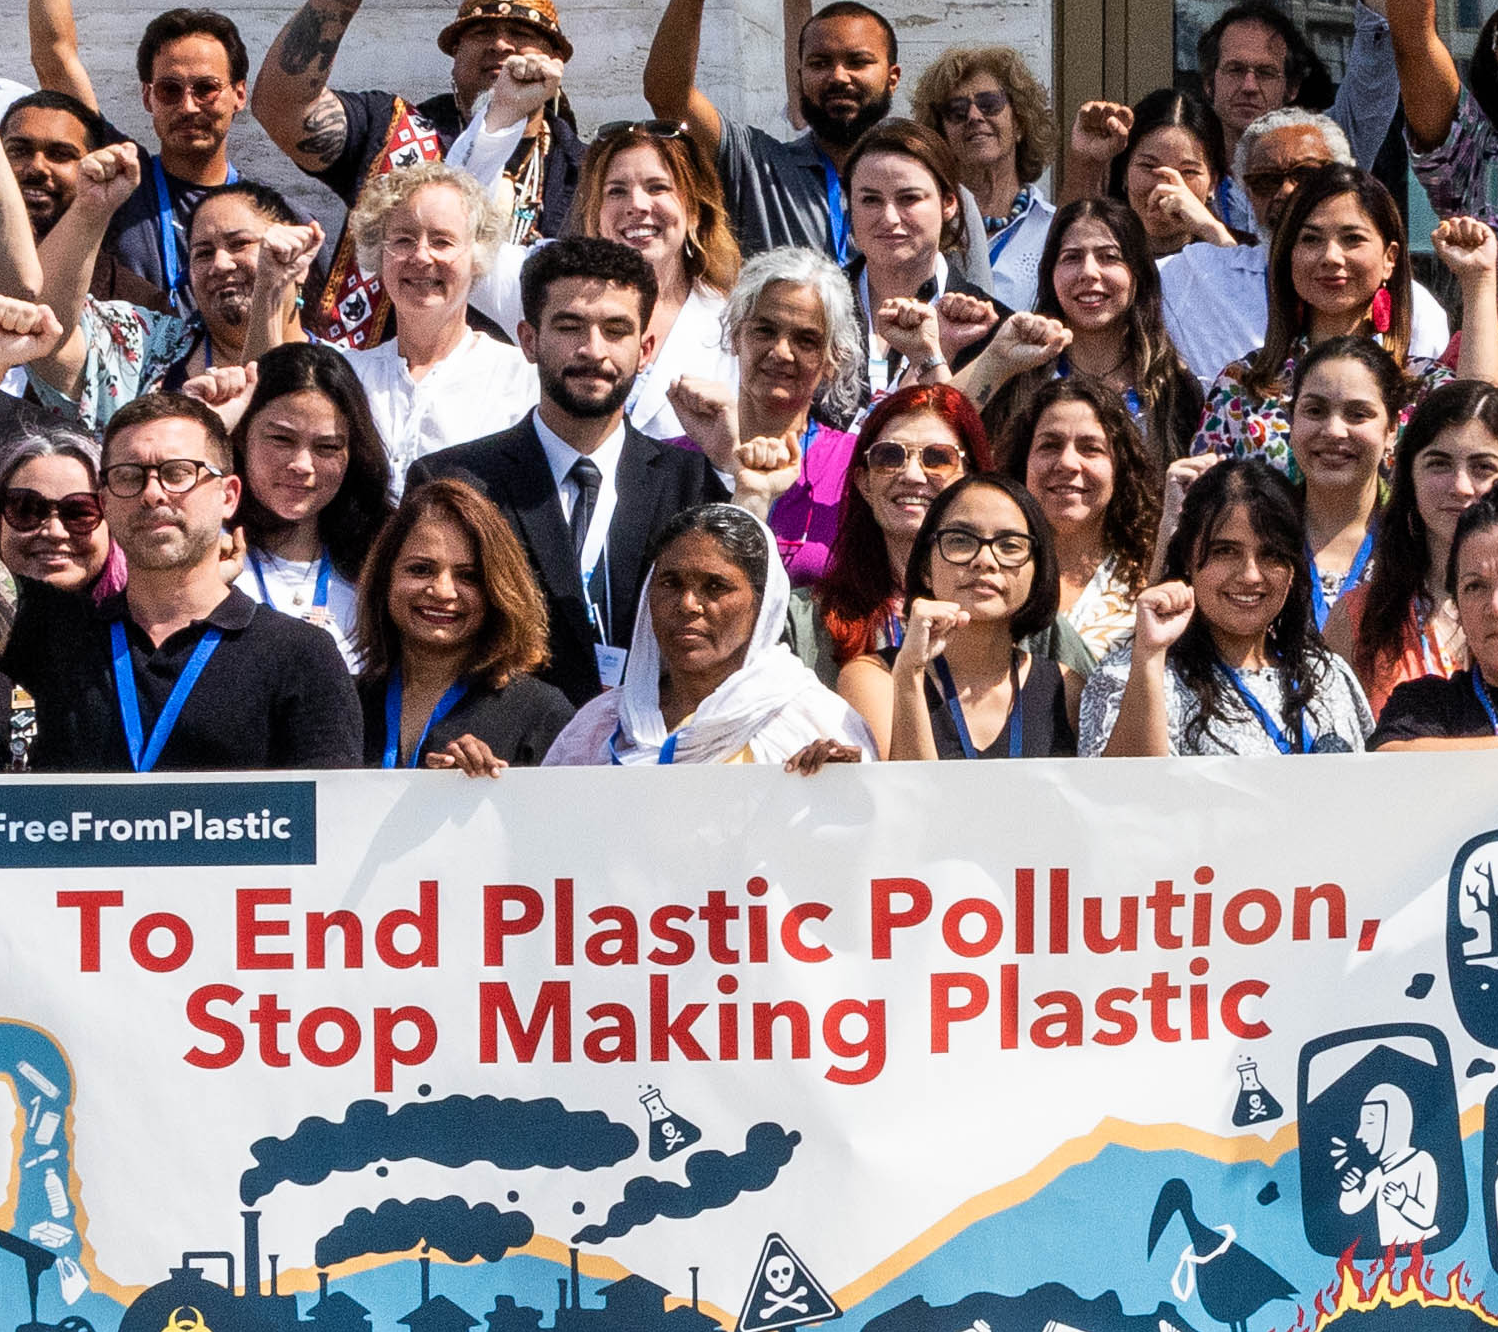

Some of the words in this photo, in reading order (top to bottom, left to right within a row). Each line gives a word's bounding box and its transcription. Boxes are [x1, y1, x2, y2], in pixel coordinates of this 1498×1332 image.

[56, 890, 194, 973] To
[236, 880, 439, 971] End
[483, 876, 833, 967] Plastic
[871, 866, 1381, 960] Pollution,
[184, 983, 438, 1093] Stop
[479, 974, 887, 1086] Making
[930, 956, 1272, 1054] Plastic
